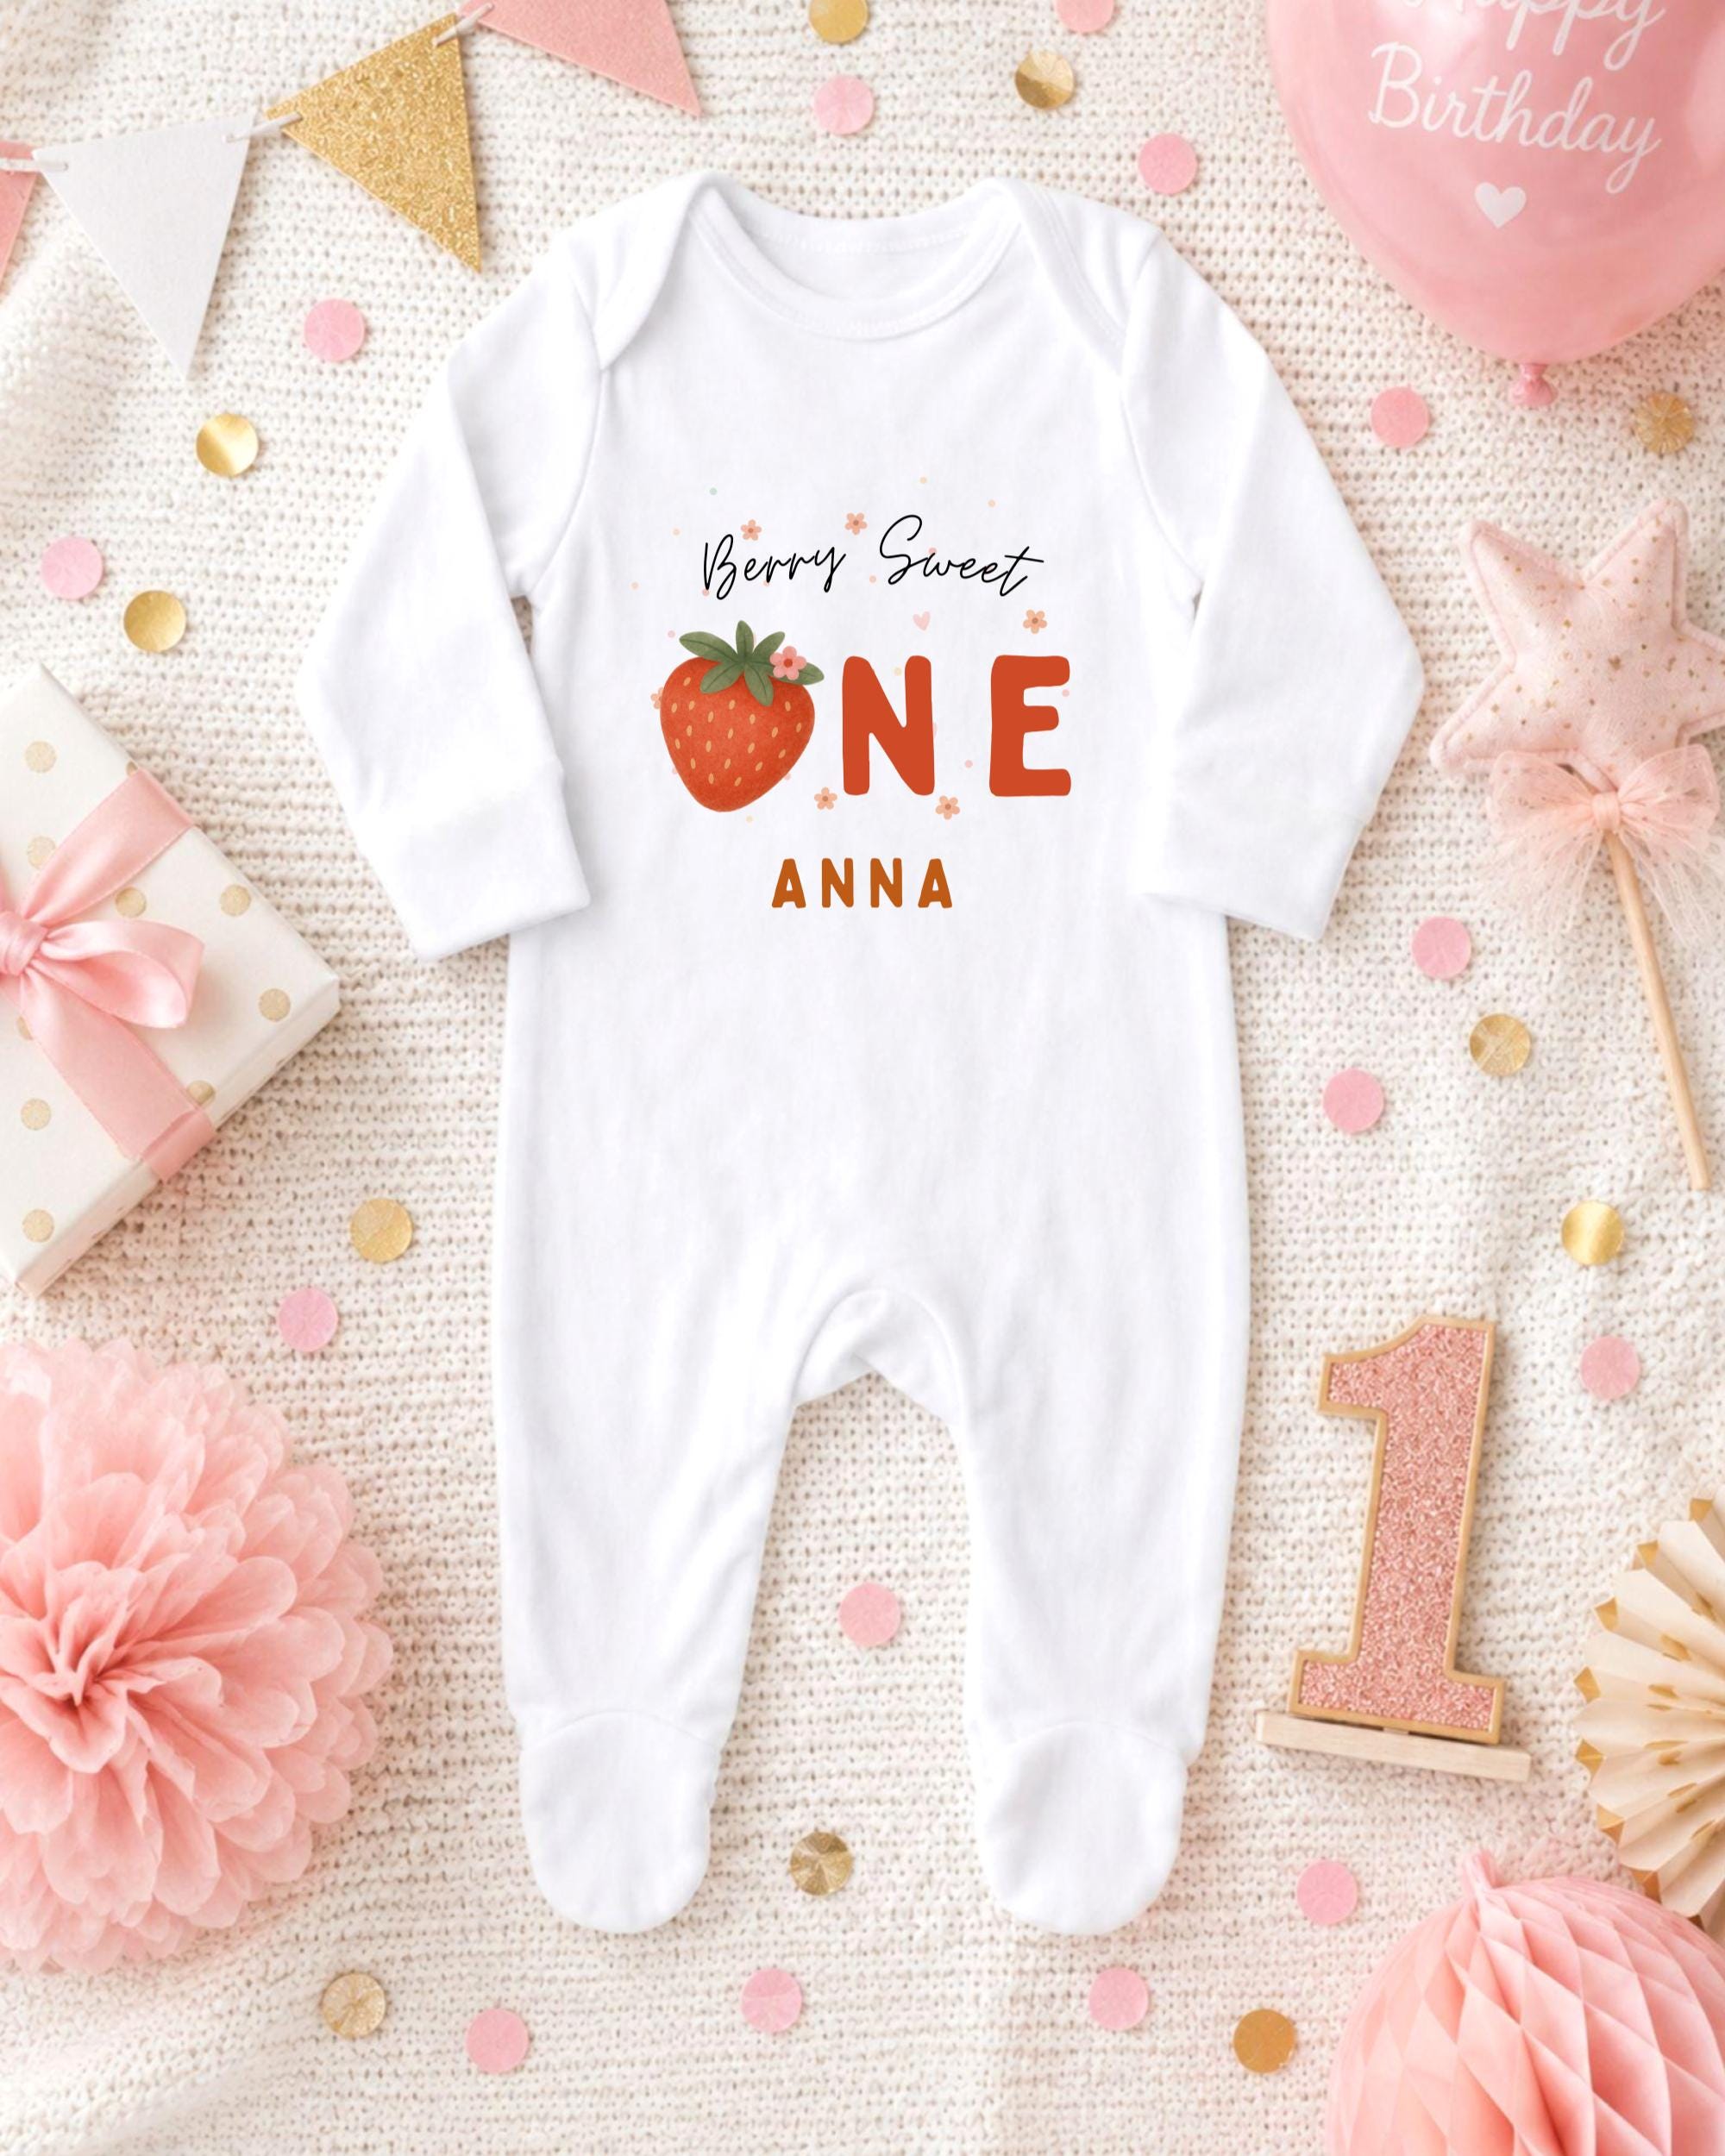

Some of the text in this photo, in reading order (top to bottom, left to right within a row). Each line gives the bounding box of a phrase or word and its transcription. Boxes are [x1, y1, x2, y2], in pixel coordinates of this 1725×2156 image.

[1368, 41, 1661, 194] Birthday
[704, 515, 1044, 599] Berry Sweet
[772, 858, 952, 908] ANNA
[1289, 1315, 1505, 1744] 1
